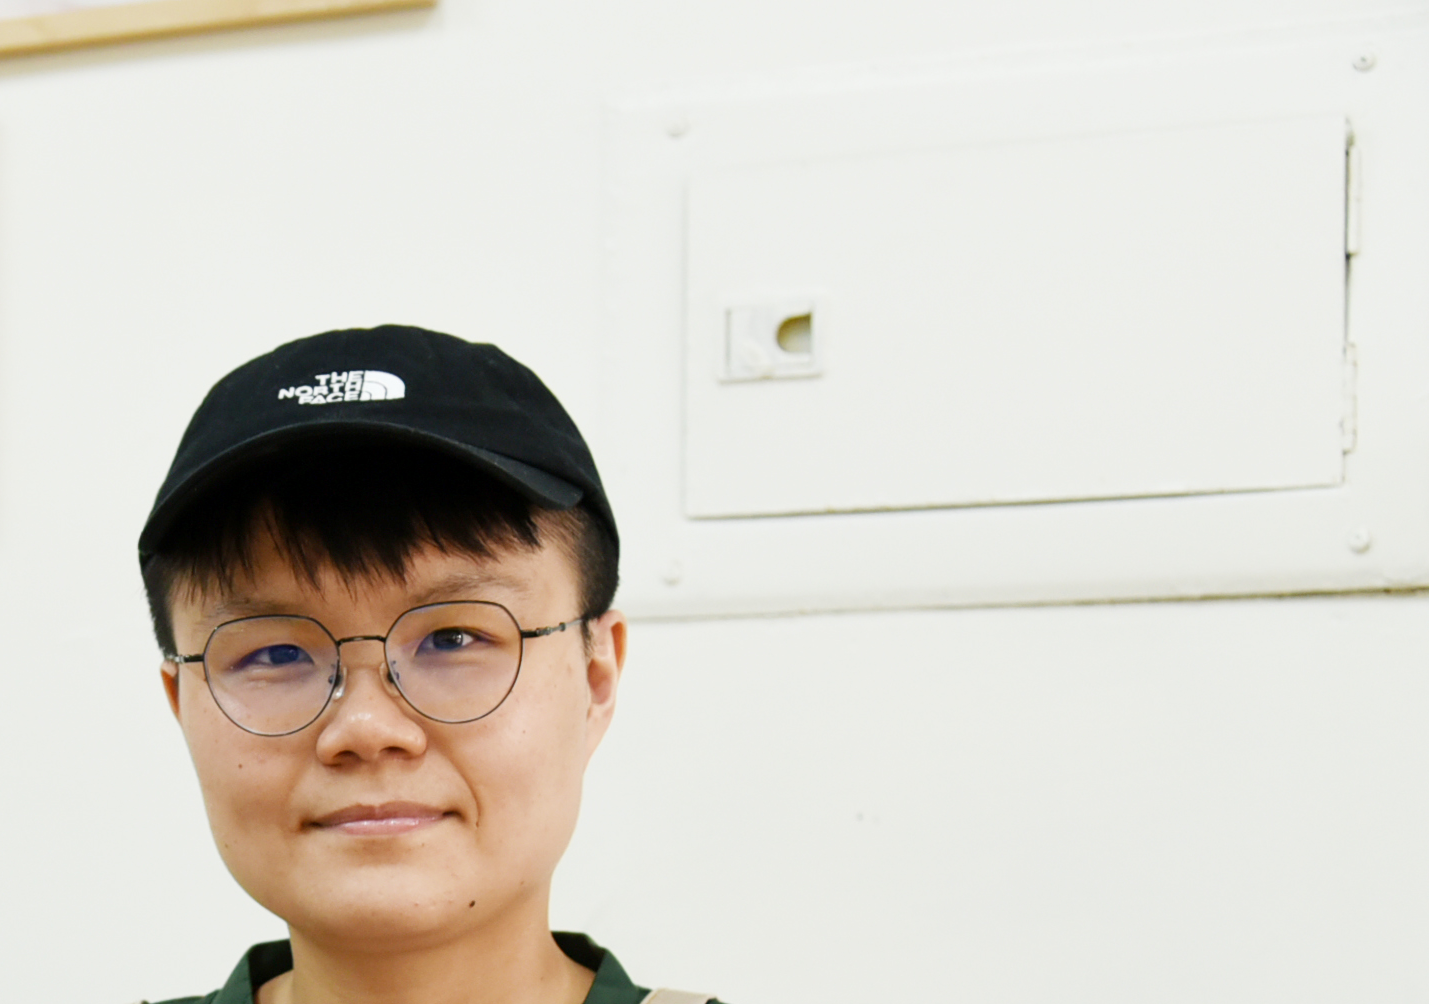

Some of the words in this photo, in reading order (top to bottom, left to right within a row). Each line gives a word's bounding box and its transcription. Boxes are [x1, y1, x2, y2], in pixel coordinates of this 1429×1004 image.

[315, 370, 364, 386] THE
[278, 379, 362, 400] NORTH
[298, 390, 361, 405] FACE
